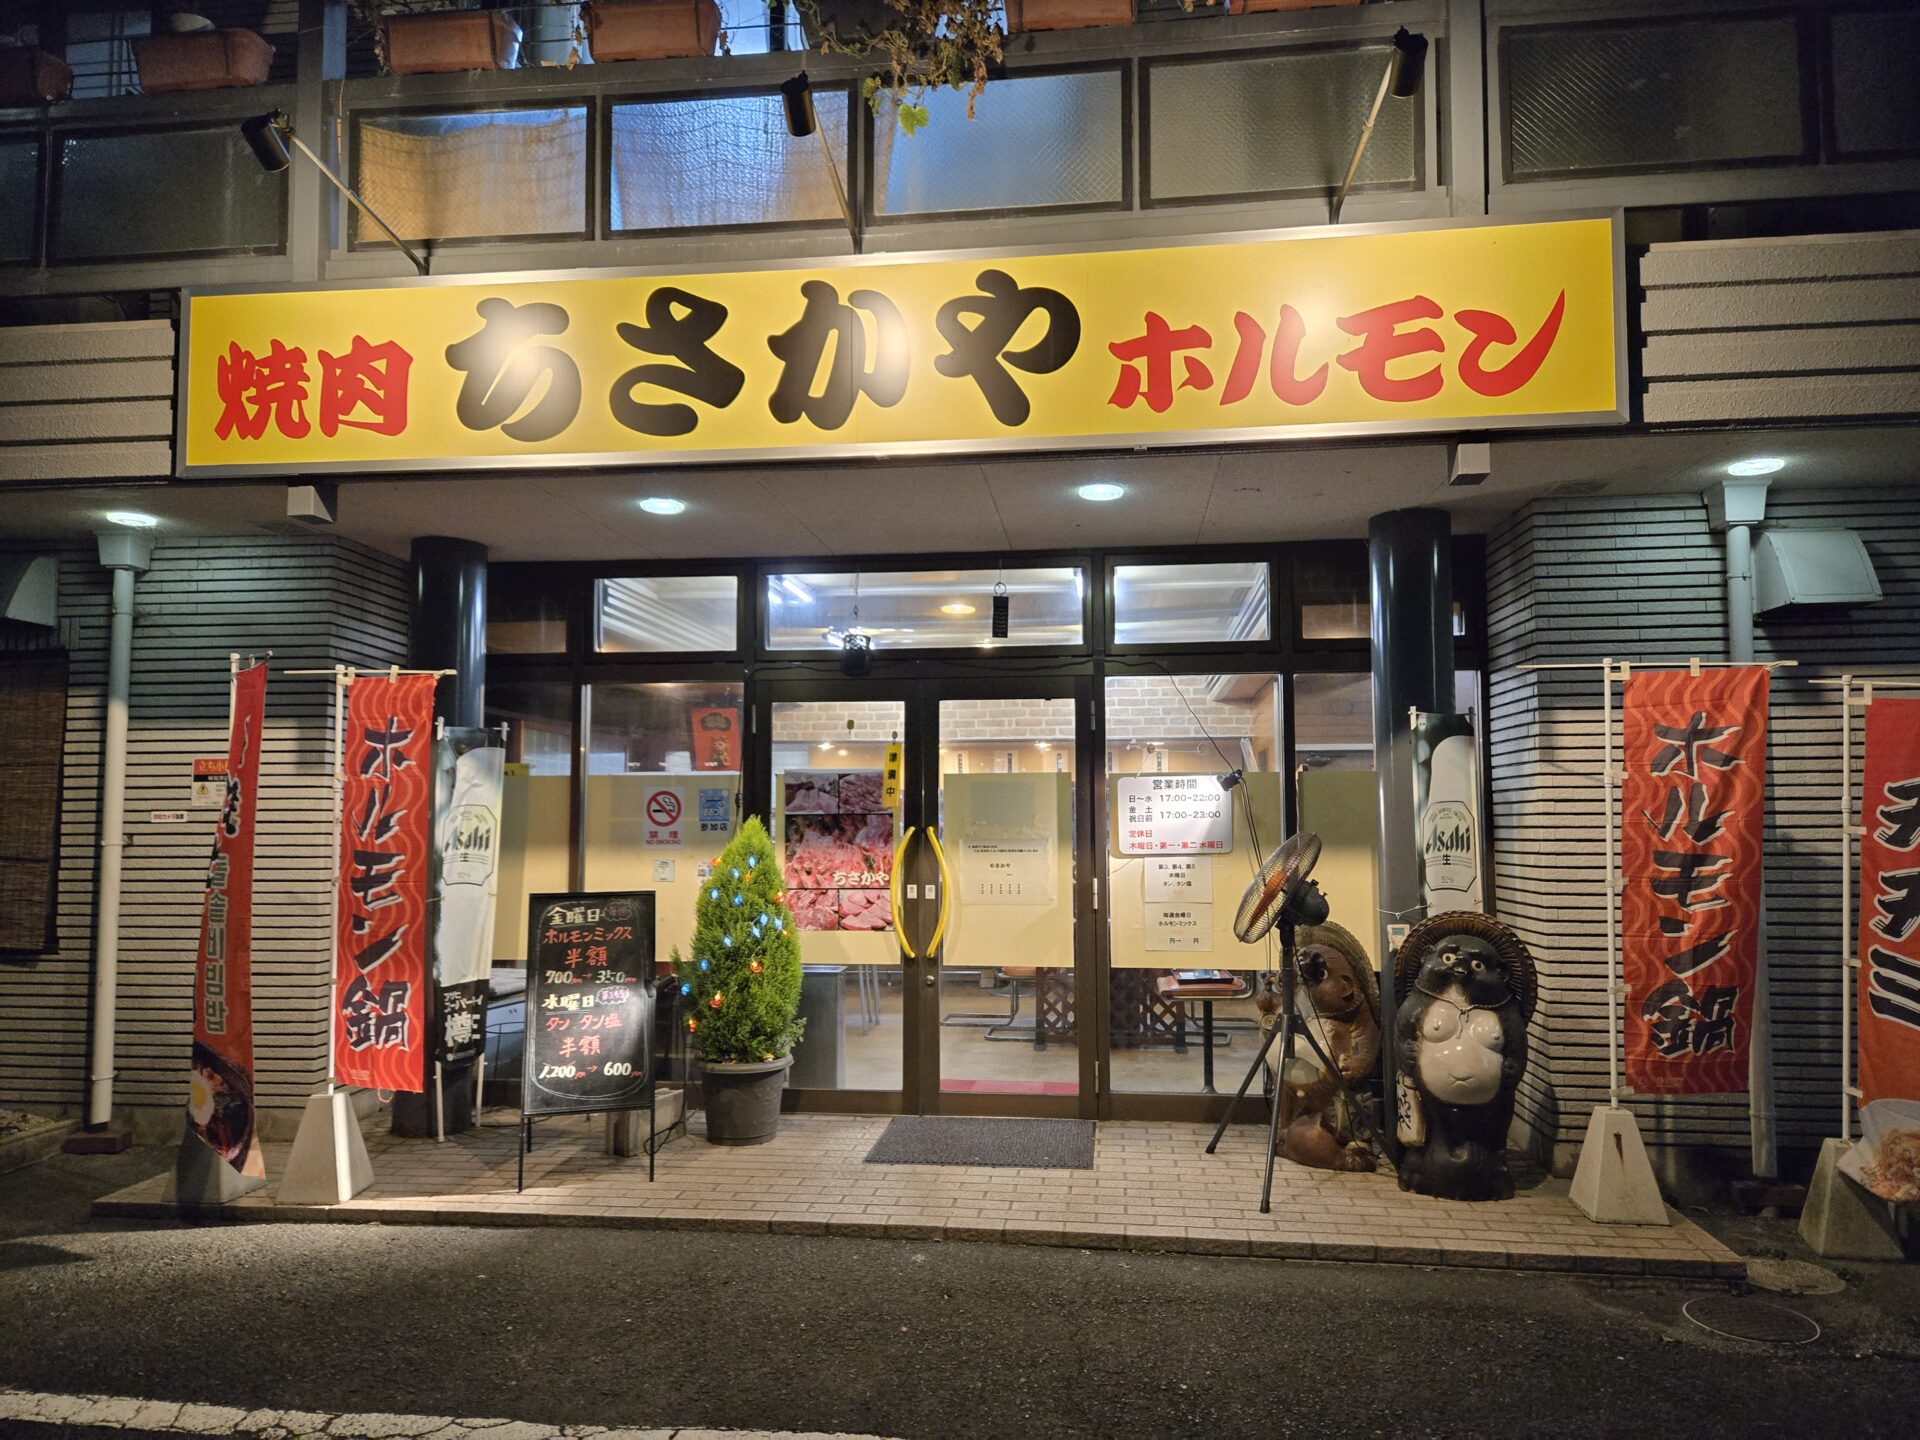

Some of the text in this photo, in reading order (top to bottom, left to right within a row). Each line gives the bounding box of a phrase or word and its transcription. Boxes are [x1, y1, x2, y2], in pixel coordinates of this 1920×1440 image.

[214, 268, 1566, 442] 焼肉 あさかや ホルモン
[199, 760, 228, 771] 立ち小
[885, 752, 897, 796] 準備中
[1152, 779, 1197, 790] 営業時間
[1129, 815, 1153, 823] 祝日前
[1129, 829, 1153, 838] 定休日
[1426, 823, 1471, 855] Asahi
[1442, 853, 1452, 866] 生
[342, 714, 416, 1051] ホルモン鍋
[1641, 711, 1745, 1057] ホルモン鍋
[547, 906, 600, 925] 金曜日
[542, 926, 633, 944] ホルモンミックス
[564, 945, 608, 968] 半額
[541, 993, 595, 1011] 水曜日
[559, 1035, 601, 1058] 半額
[603, 1062, 632, 1076] 600
